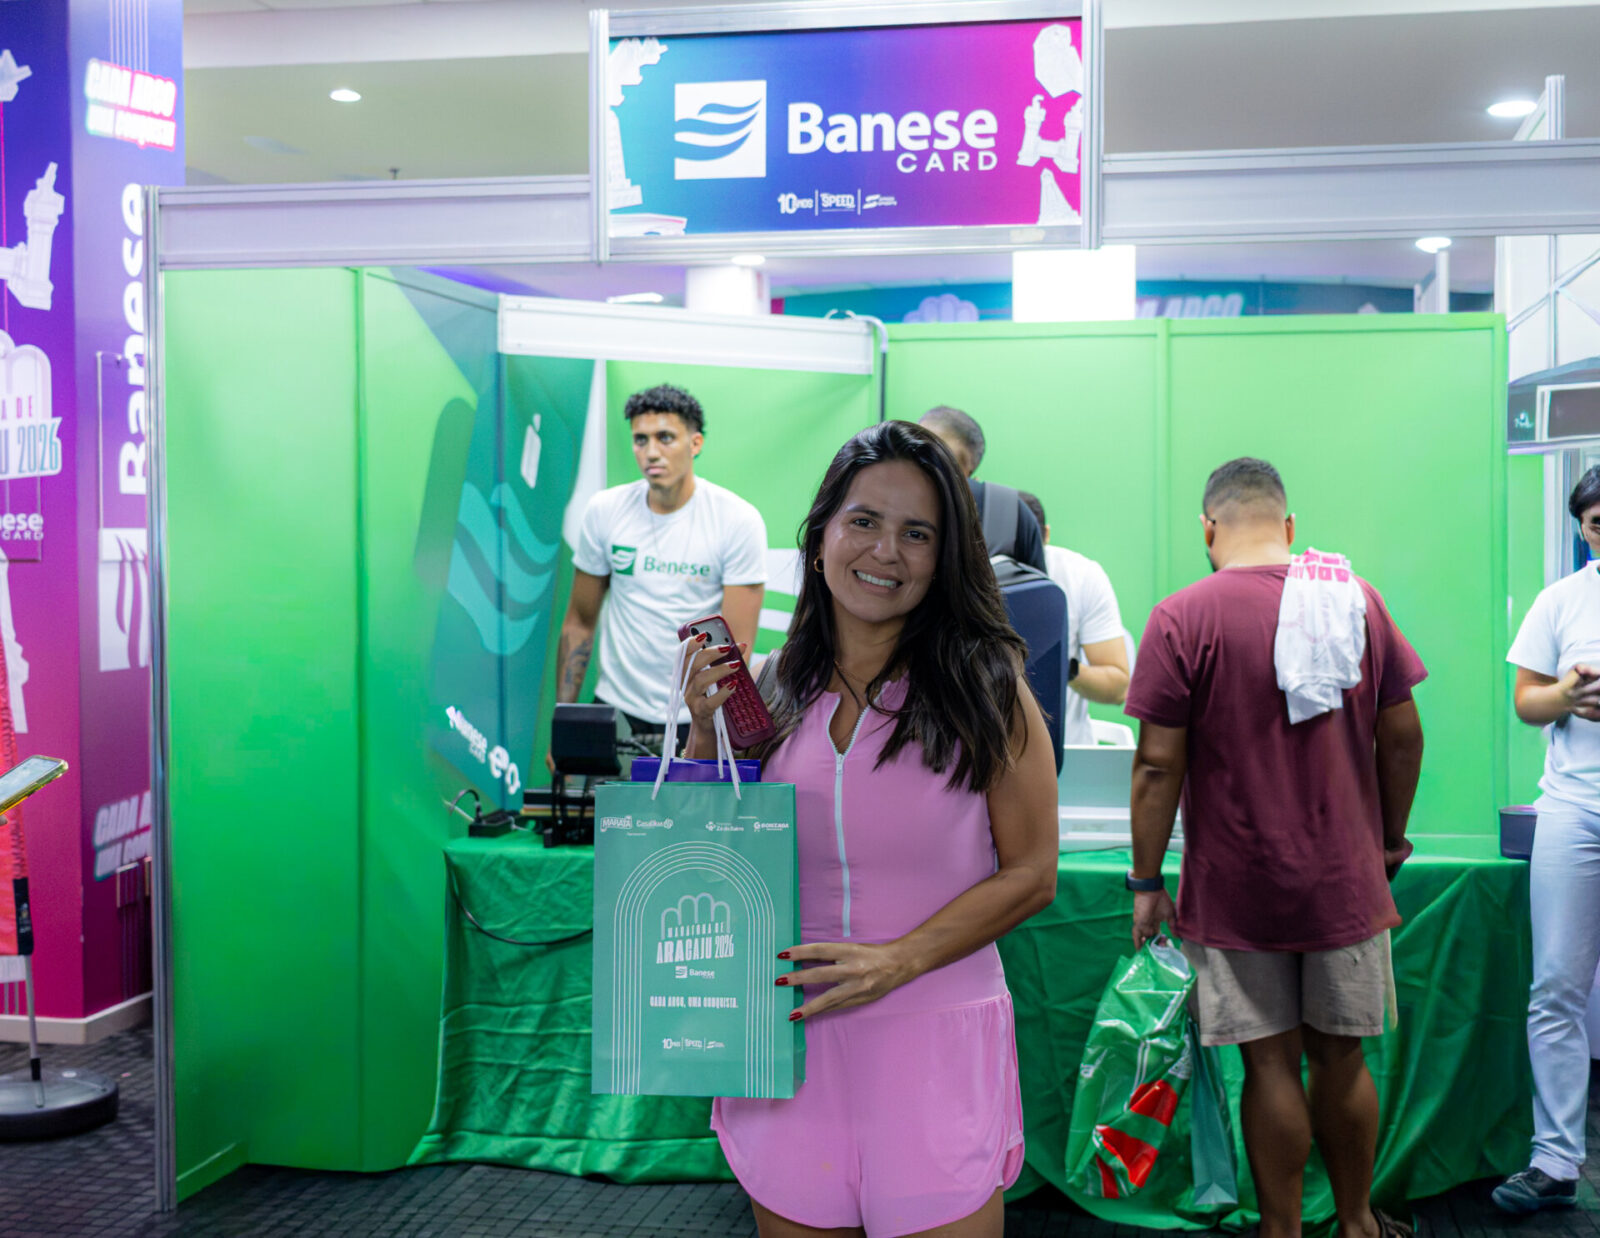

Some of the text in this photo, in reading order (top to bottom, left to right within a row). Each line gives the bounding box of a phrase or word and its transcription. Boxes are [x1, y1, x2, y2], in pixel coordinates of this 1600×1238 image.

[788, 102, 998, 154] Banese
[896, 151, 998, 173] CARD
[17, 422, 58, 474] 2026
[0, 513, 44, 531] ese
[643, 556, 710, 577] Banese
[656, 934, 734, 964] ARACAJU 2026
[689, 969, 715, 977] Banese
